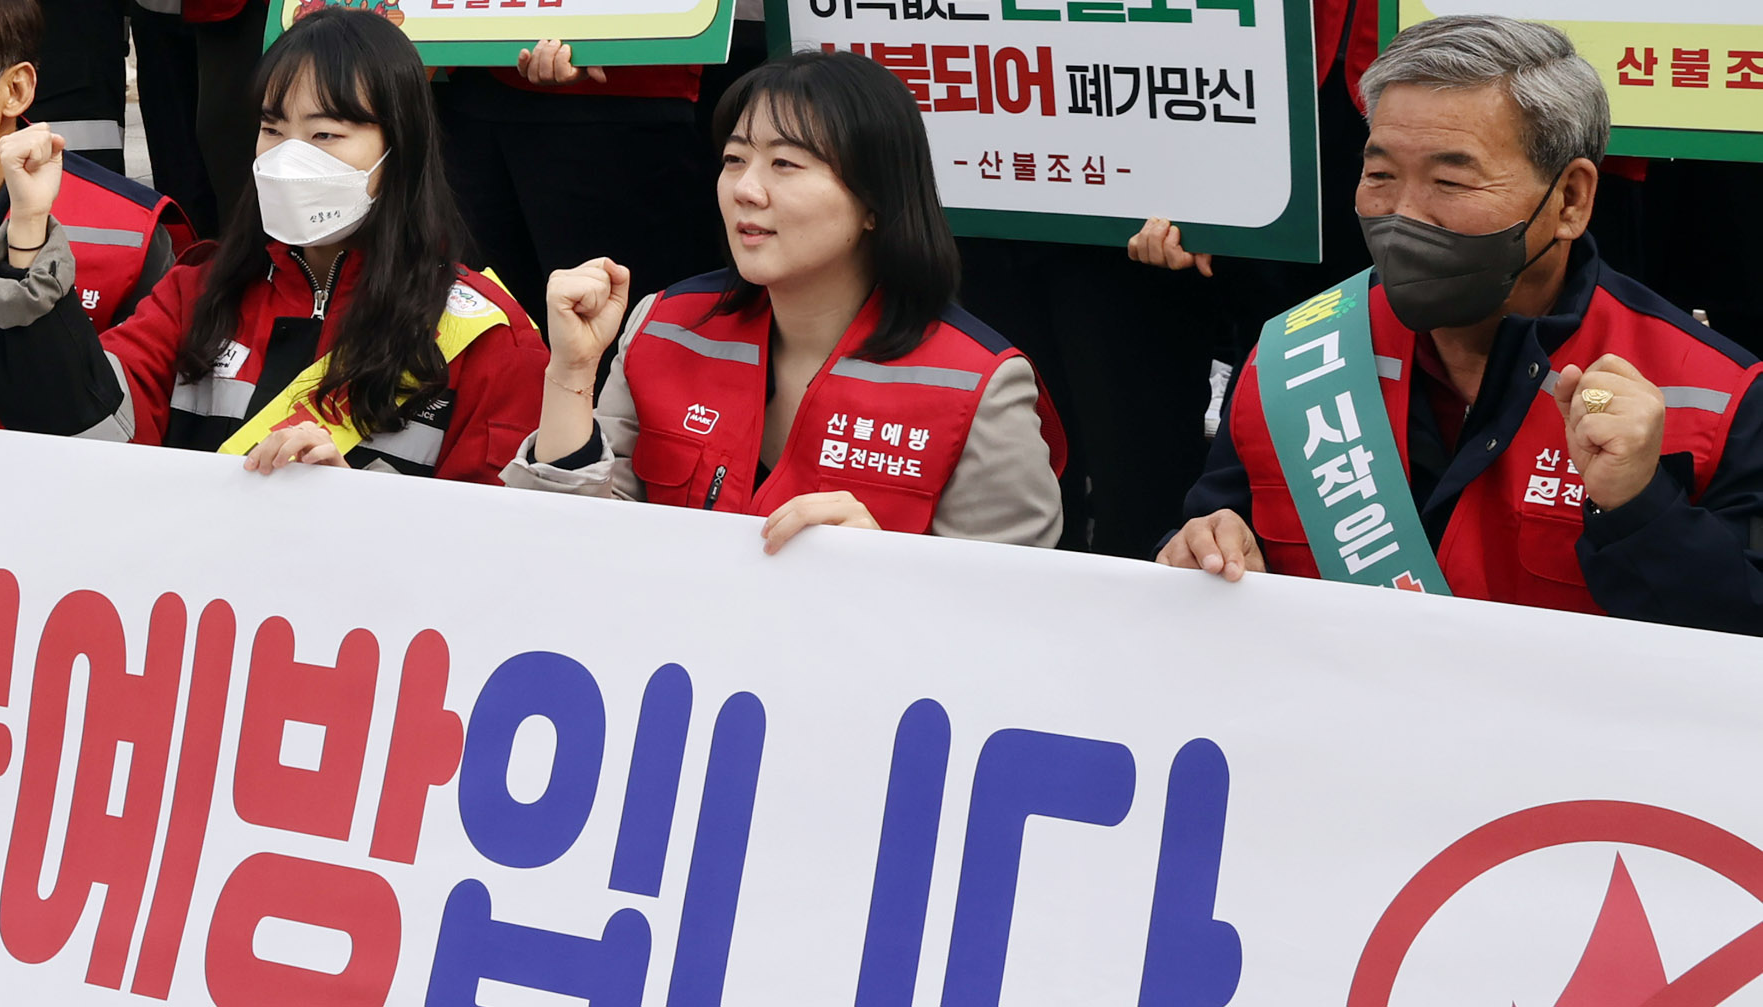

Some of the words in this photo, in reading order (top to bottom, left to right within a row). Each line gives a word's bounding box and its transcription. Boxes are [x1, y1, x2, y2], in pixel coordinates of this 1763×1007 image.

[821, 42, 1057, 117] 불되어
[1065, 63, 1257, 126] 폐가망신
[1285, 329, 1346, 391] 그
[826, 412, 930, 451] 산불예방
[848, 446, 923, 478] 전라남도
[1302, 390, 1401, 576] 시작은
